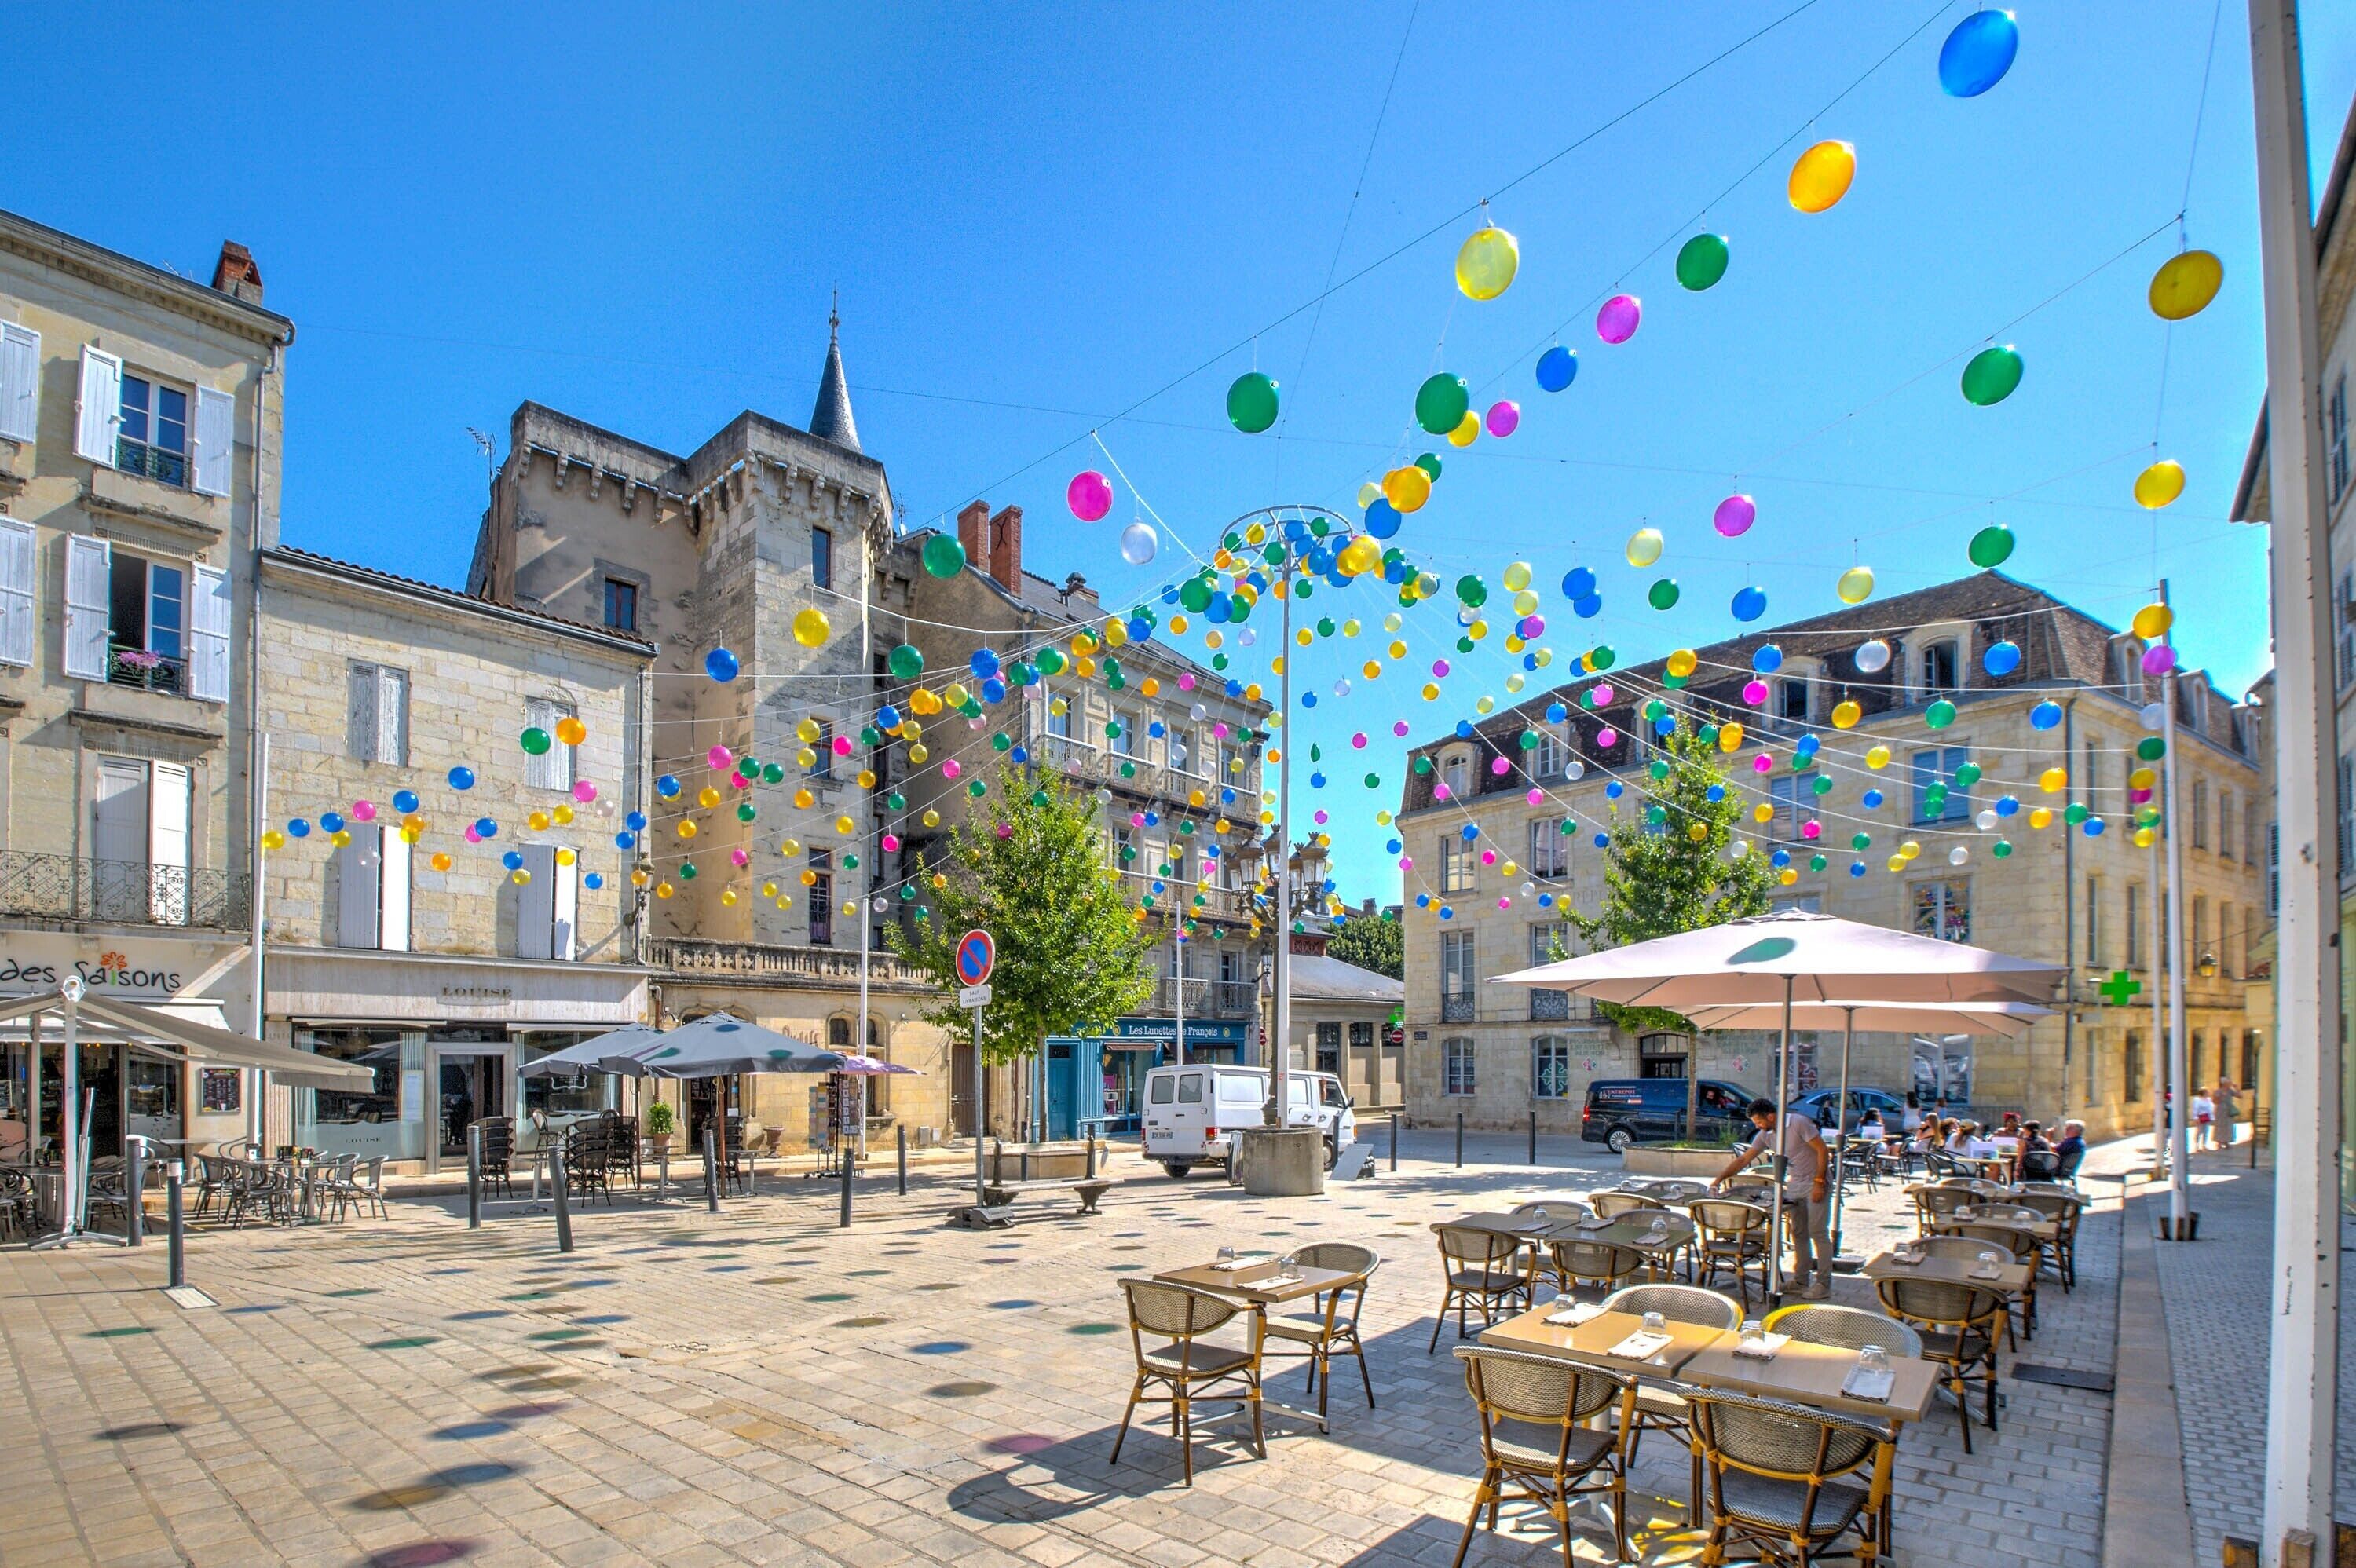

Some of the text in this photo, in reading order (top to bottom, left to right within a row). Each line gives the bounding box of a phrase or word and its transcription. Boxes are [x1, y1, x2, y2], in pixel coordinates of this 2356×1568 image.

[1, 959, 181, 992] des Saisons
[443, 986, 511, 997] LOUISE
[1129, 1025, 1143, 1035] Les
[1144, 1025, 1176, 1036] Lunettes
[1187, 1026, 1218, 1038] Français
